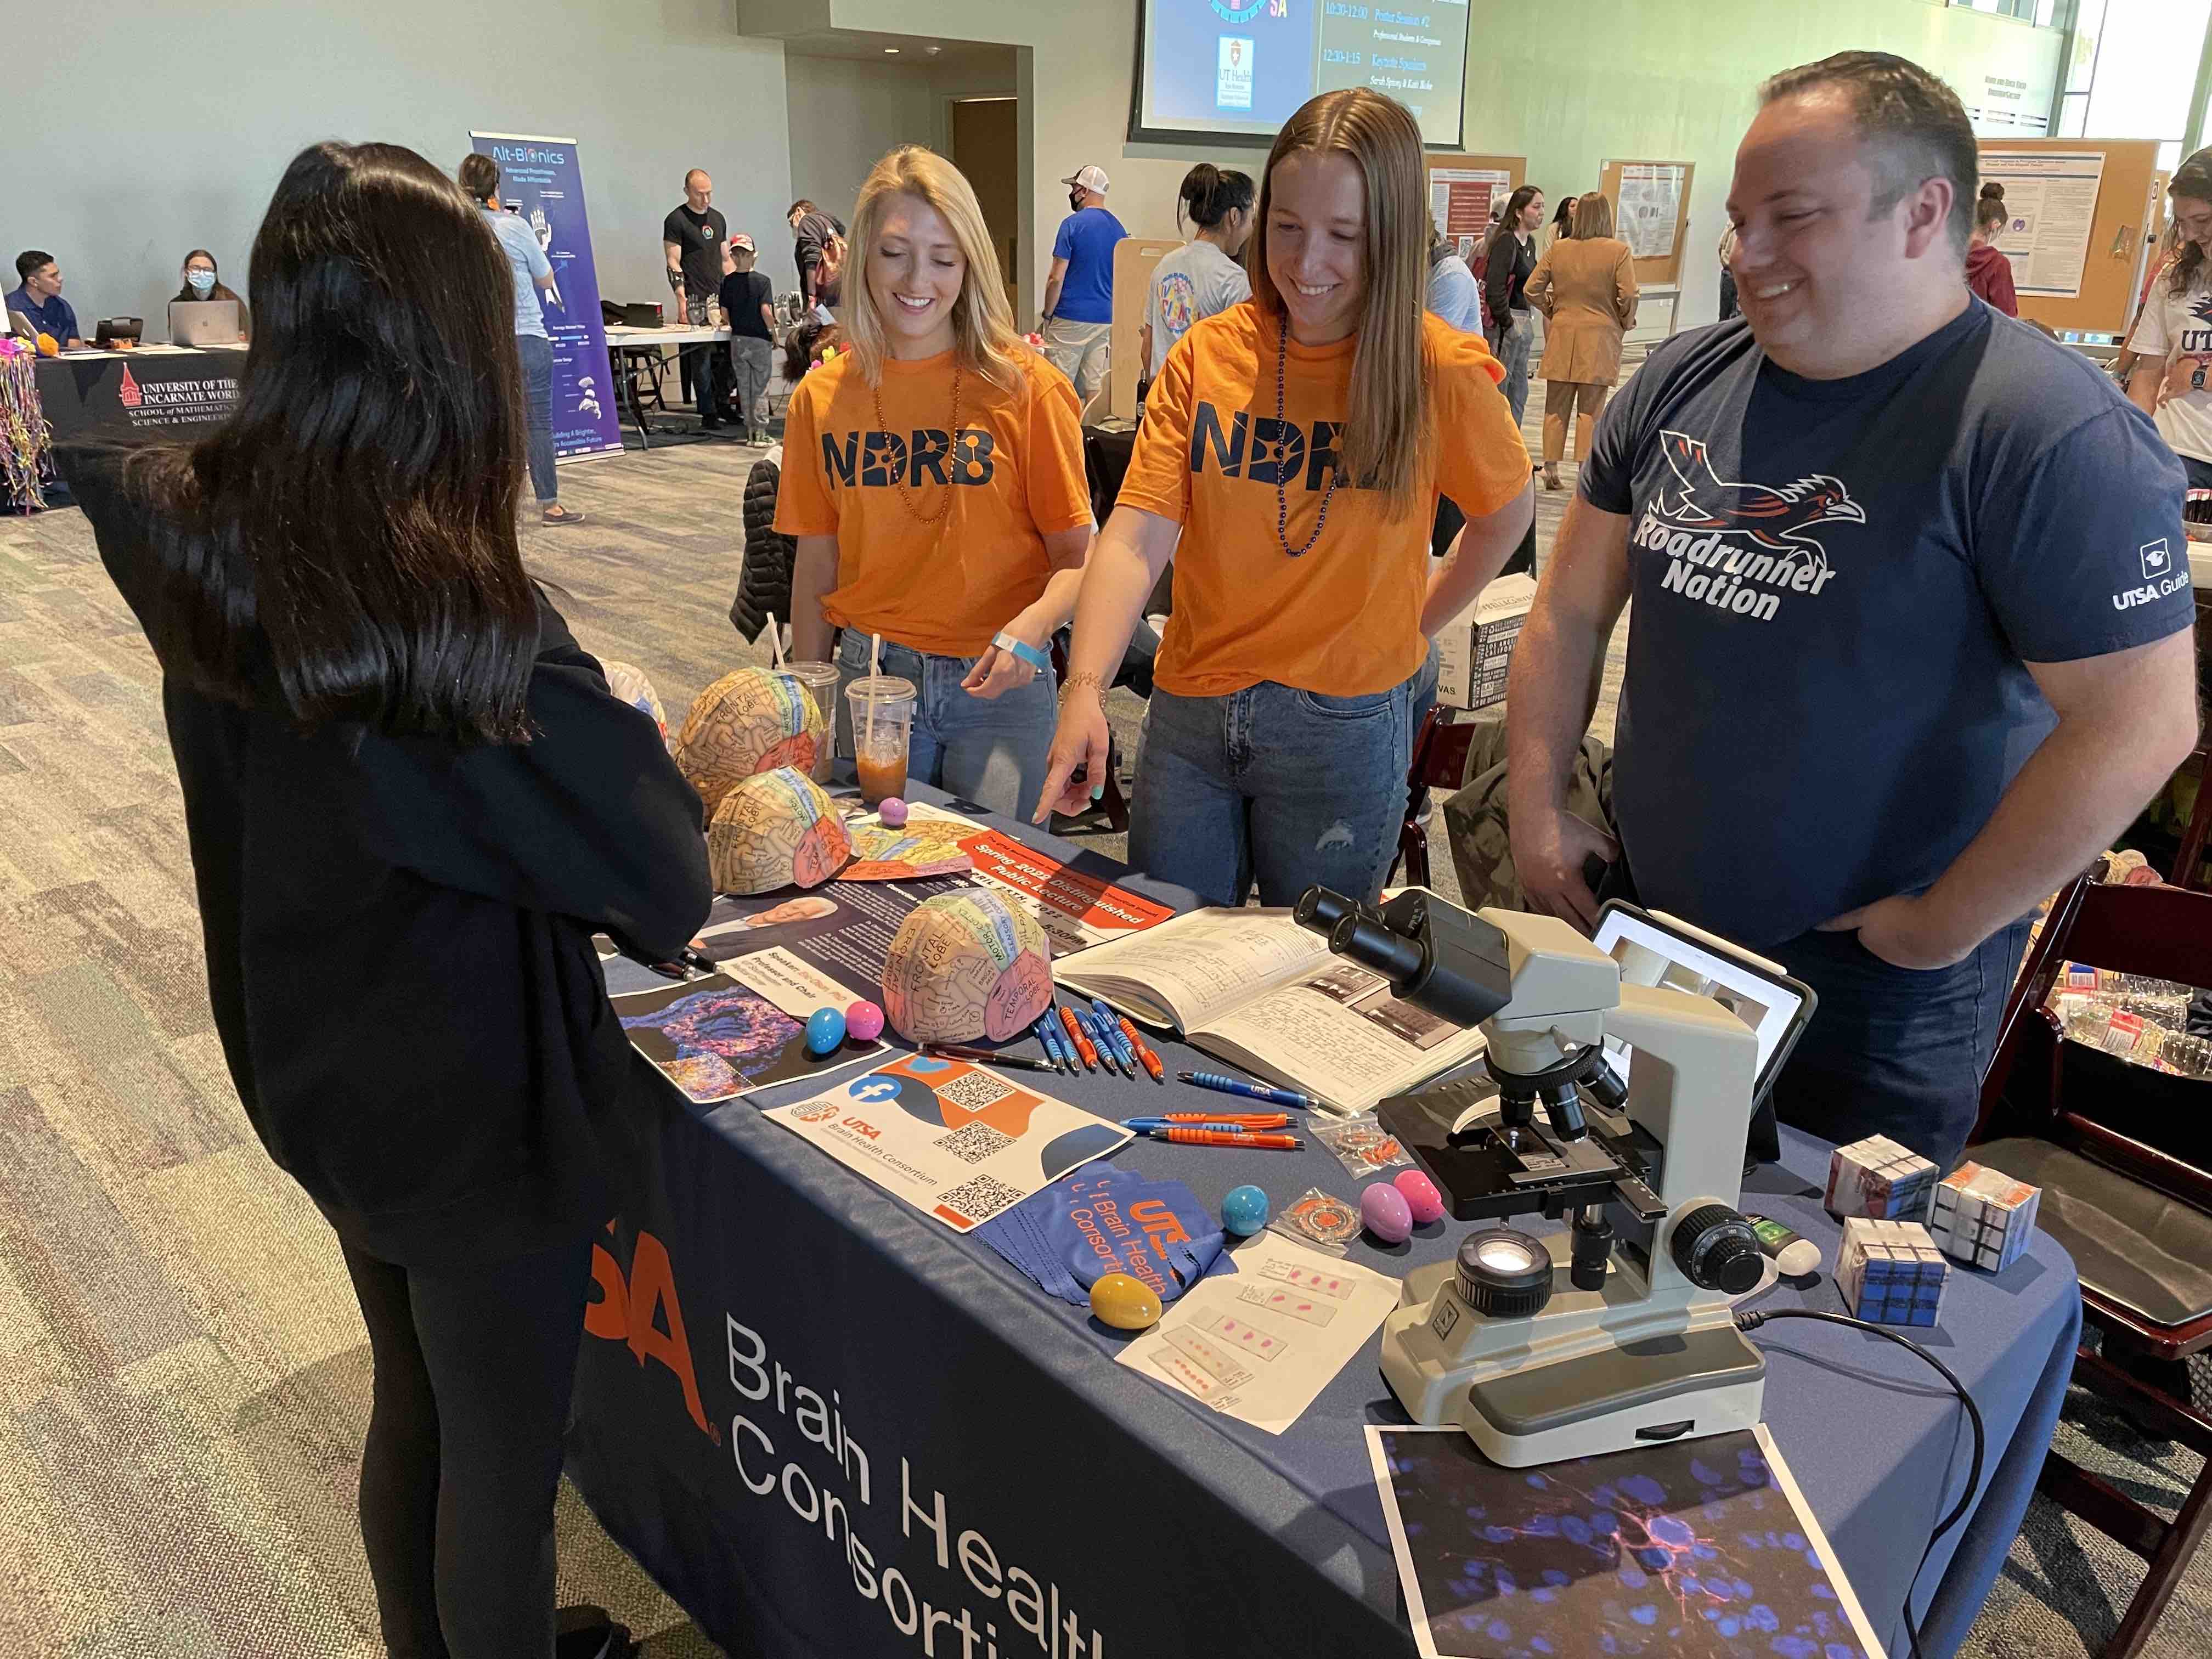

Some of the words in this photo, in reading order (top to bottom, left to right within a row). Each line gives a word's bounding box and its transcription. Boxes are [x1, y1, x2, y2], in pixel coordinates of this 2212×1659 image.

[1220, 69, 1231, 81] UT
[493, 145, 565, 165] Alt-Bionics
[142, 381, 200, 394] UNIVERSITY
[202, 380, 215, 391] OF
[216, 379, 238, 390] THE
[144, 392, 206, 405] INCARNATE
[128, 408, 165, 417] SCHOOL
[167, 408, 175, 416] of
[132, 417, 170, 427] SCIENCE
[821, 429, 994, 491] NDRB
[1633, 514, 1836, 595] Roadrunner
[1661, 558, 1780, 621] Nation
[2113, 584, 2161, 610] UTSA
[2160, 571, 2189, 596] Guide
[738, 698, 760, 716] LOBE
[970, 871, 992, 885] PRIL
[1032, 903, 1063, 919] 2022
[973, 844, 1015, 866] Spring
[1014, 858, 1052, 881] 2022
[1048, 879, 1146, 925] Distinguished
[990, 865, 1032, 886] Public
[1030, 884, 1085, 911] Lecture
[983, 931, 1005, 961] MOTOR
[1042, 924, 1088, 945] 5:30PM
[929, 938, 952, 969] LOBE
[1005, 978, 1037, 1020] TEMPORAL
[1025, 984, 1041, 1001] LOBE
[1251, 1085, 1271, 1096] UTSA
[842, 1116, 882, 1141] UTSA
[827, 1123, 853, 1139] Brain
[851, 1133, 883, 1156] Health
[882, 1153, 938, 1187] Consortium
[1070, 1209, 1126, 1274] Consorti
[1094, 1200, 1131, 1238] Brain
[1121, 1239, 1167, 1296] Health
[726, 1312, 870, 1505] Brain
